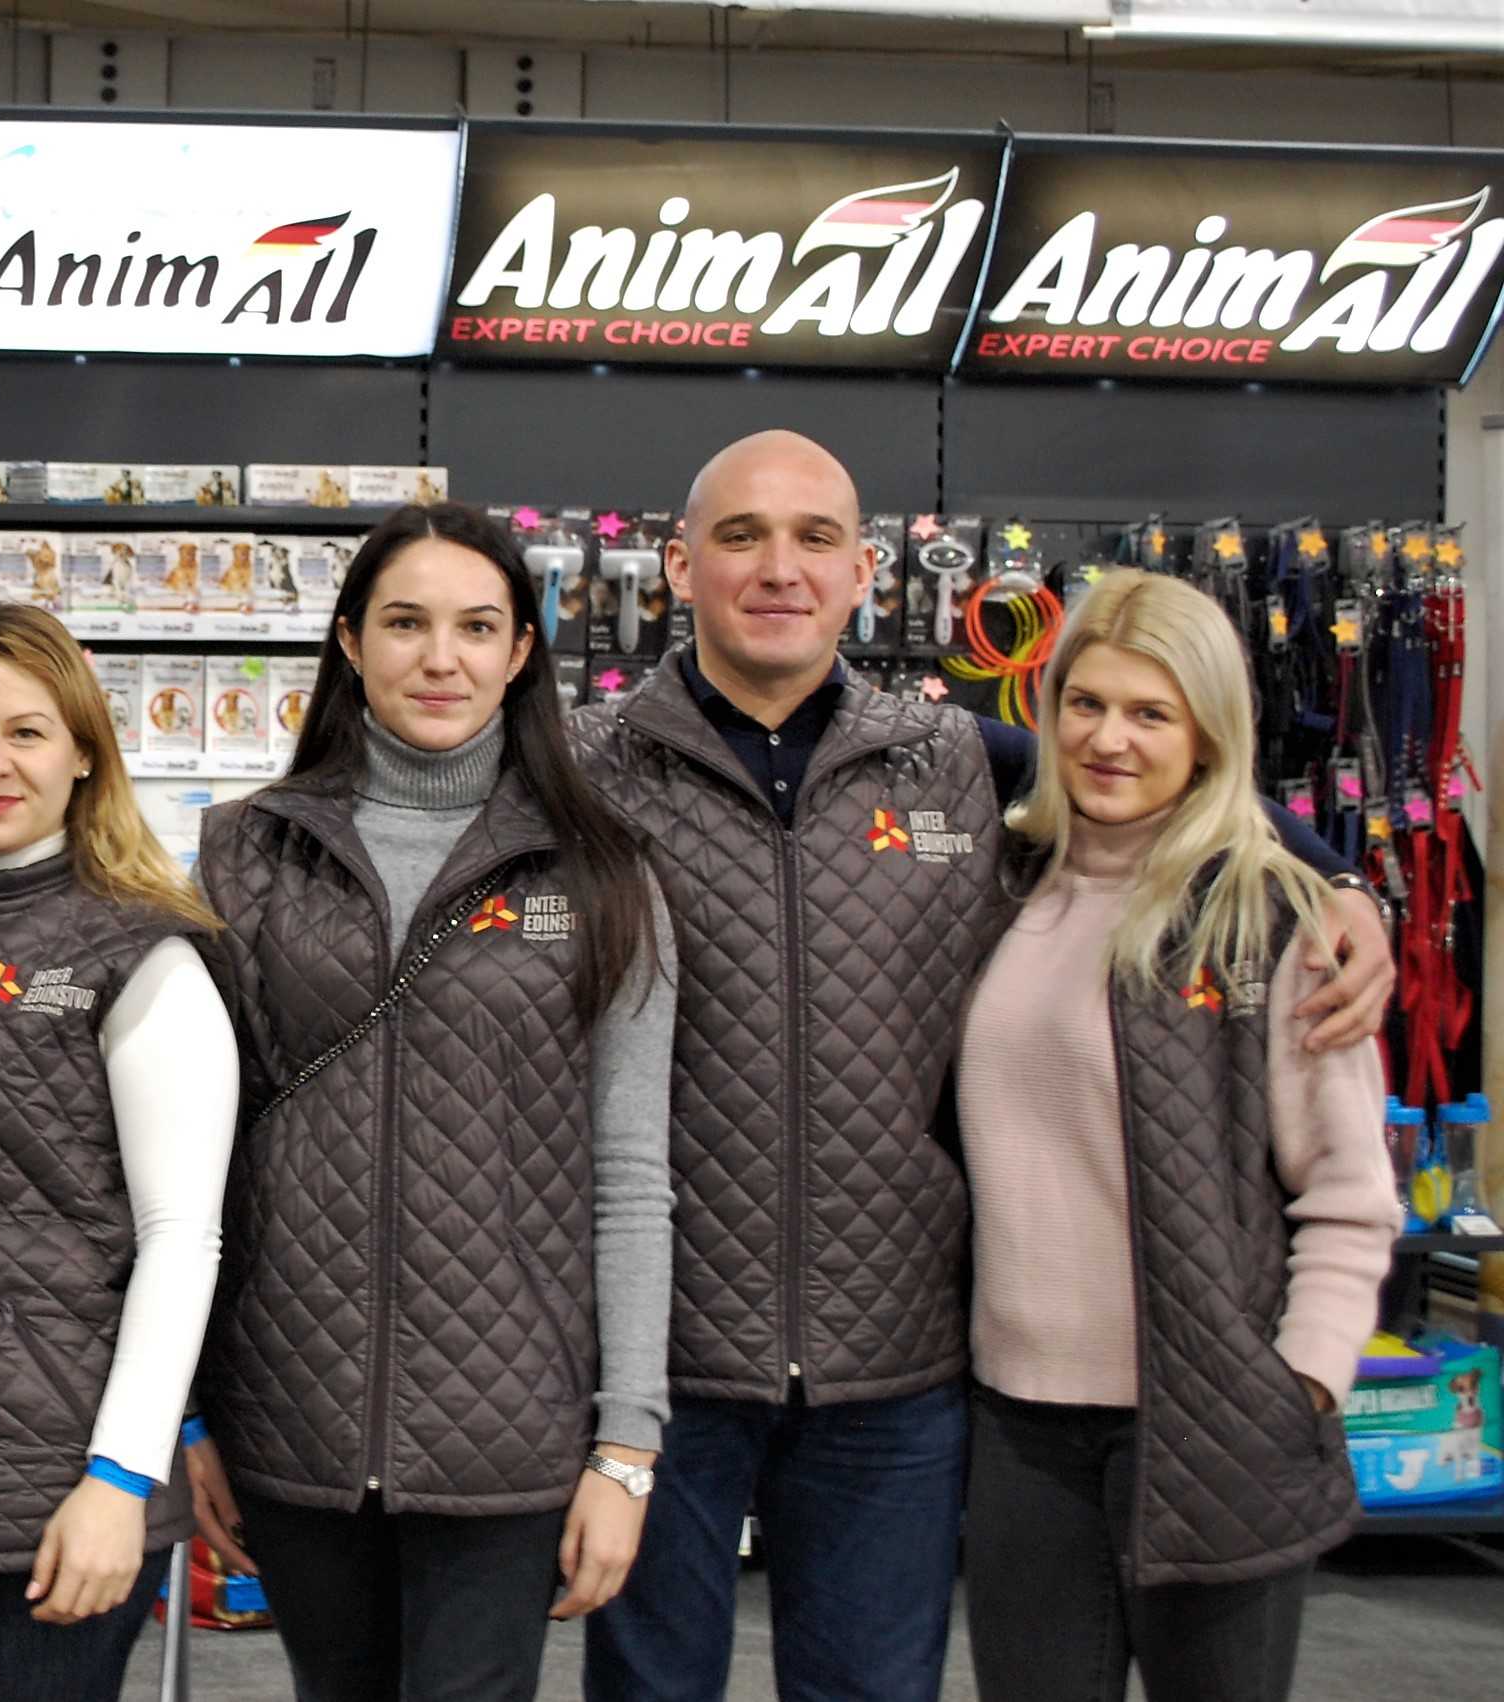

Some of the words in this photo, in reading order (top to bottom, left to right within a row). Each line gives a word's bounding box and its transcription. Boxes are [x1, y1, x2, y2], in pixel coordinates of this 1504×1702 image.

[456, 192, 985, 336] AnimAll
[989, 211, 1504, 354] AnimAll
[451, 316, 596, 343] EXPERT
[604, 320, 752, 347] CHOICE
[977, 332, 1120, 361] EXPERT
[1127, 337, 1272, 364] CHOICE
[525, 895, 568, 913] INTER
